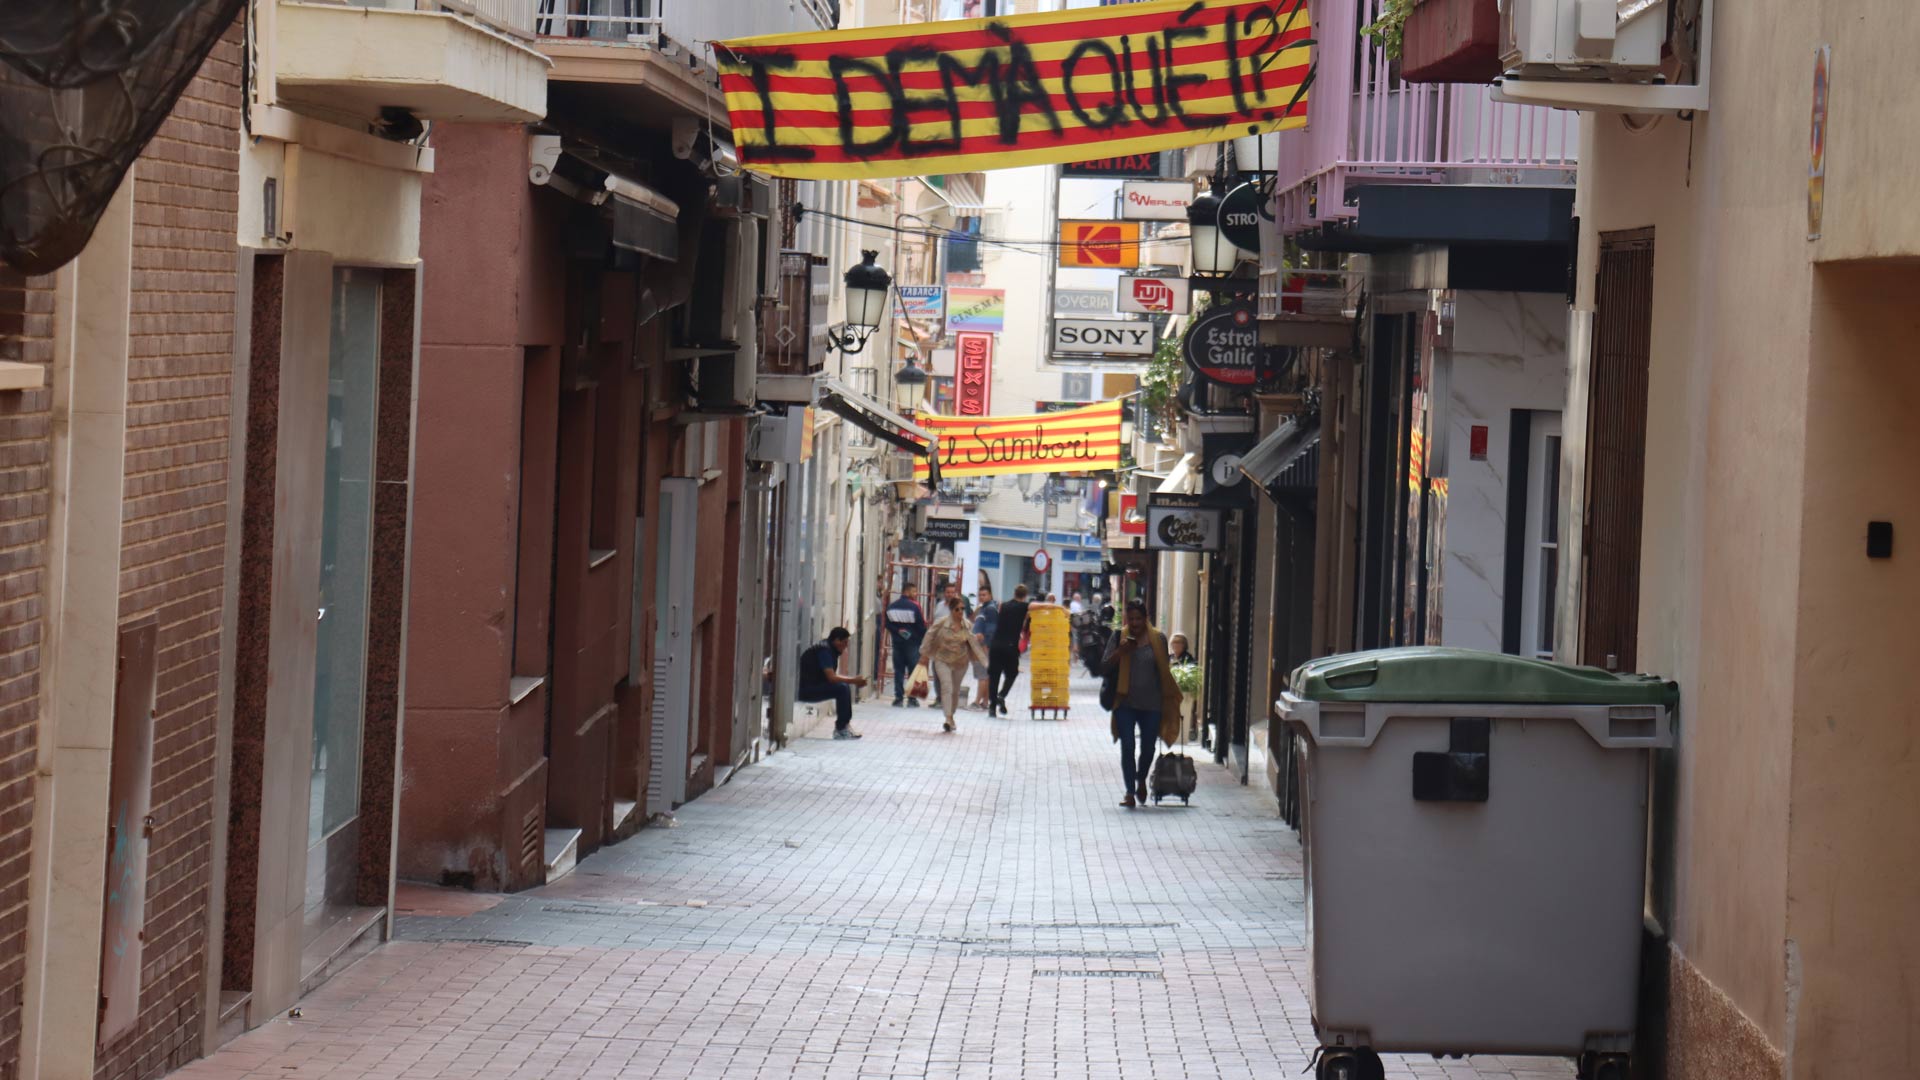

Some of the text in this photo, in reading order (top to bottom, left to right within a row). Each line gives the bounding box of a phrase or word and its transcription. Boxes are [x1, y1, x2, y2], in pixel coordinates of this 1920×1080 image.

[902, 286, 939, 296] TABARCA
[1056, 294, 1110, 309] OYERIA
[950, 295, 1001, 325] CINEMA
[1059, 327, 1149, 346] SONY
[963, 340, 985, 385] SEX
[967, 424, 1097, 464] Sambori
